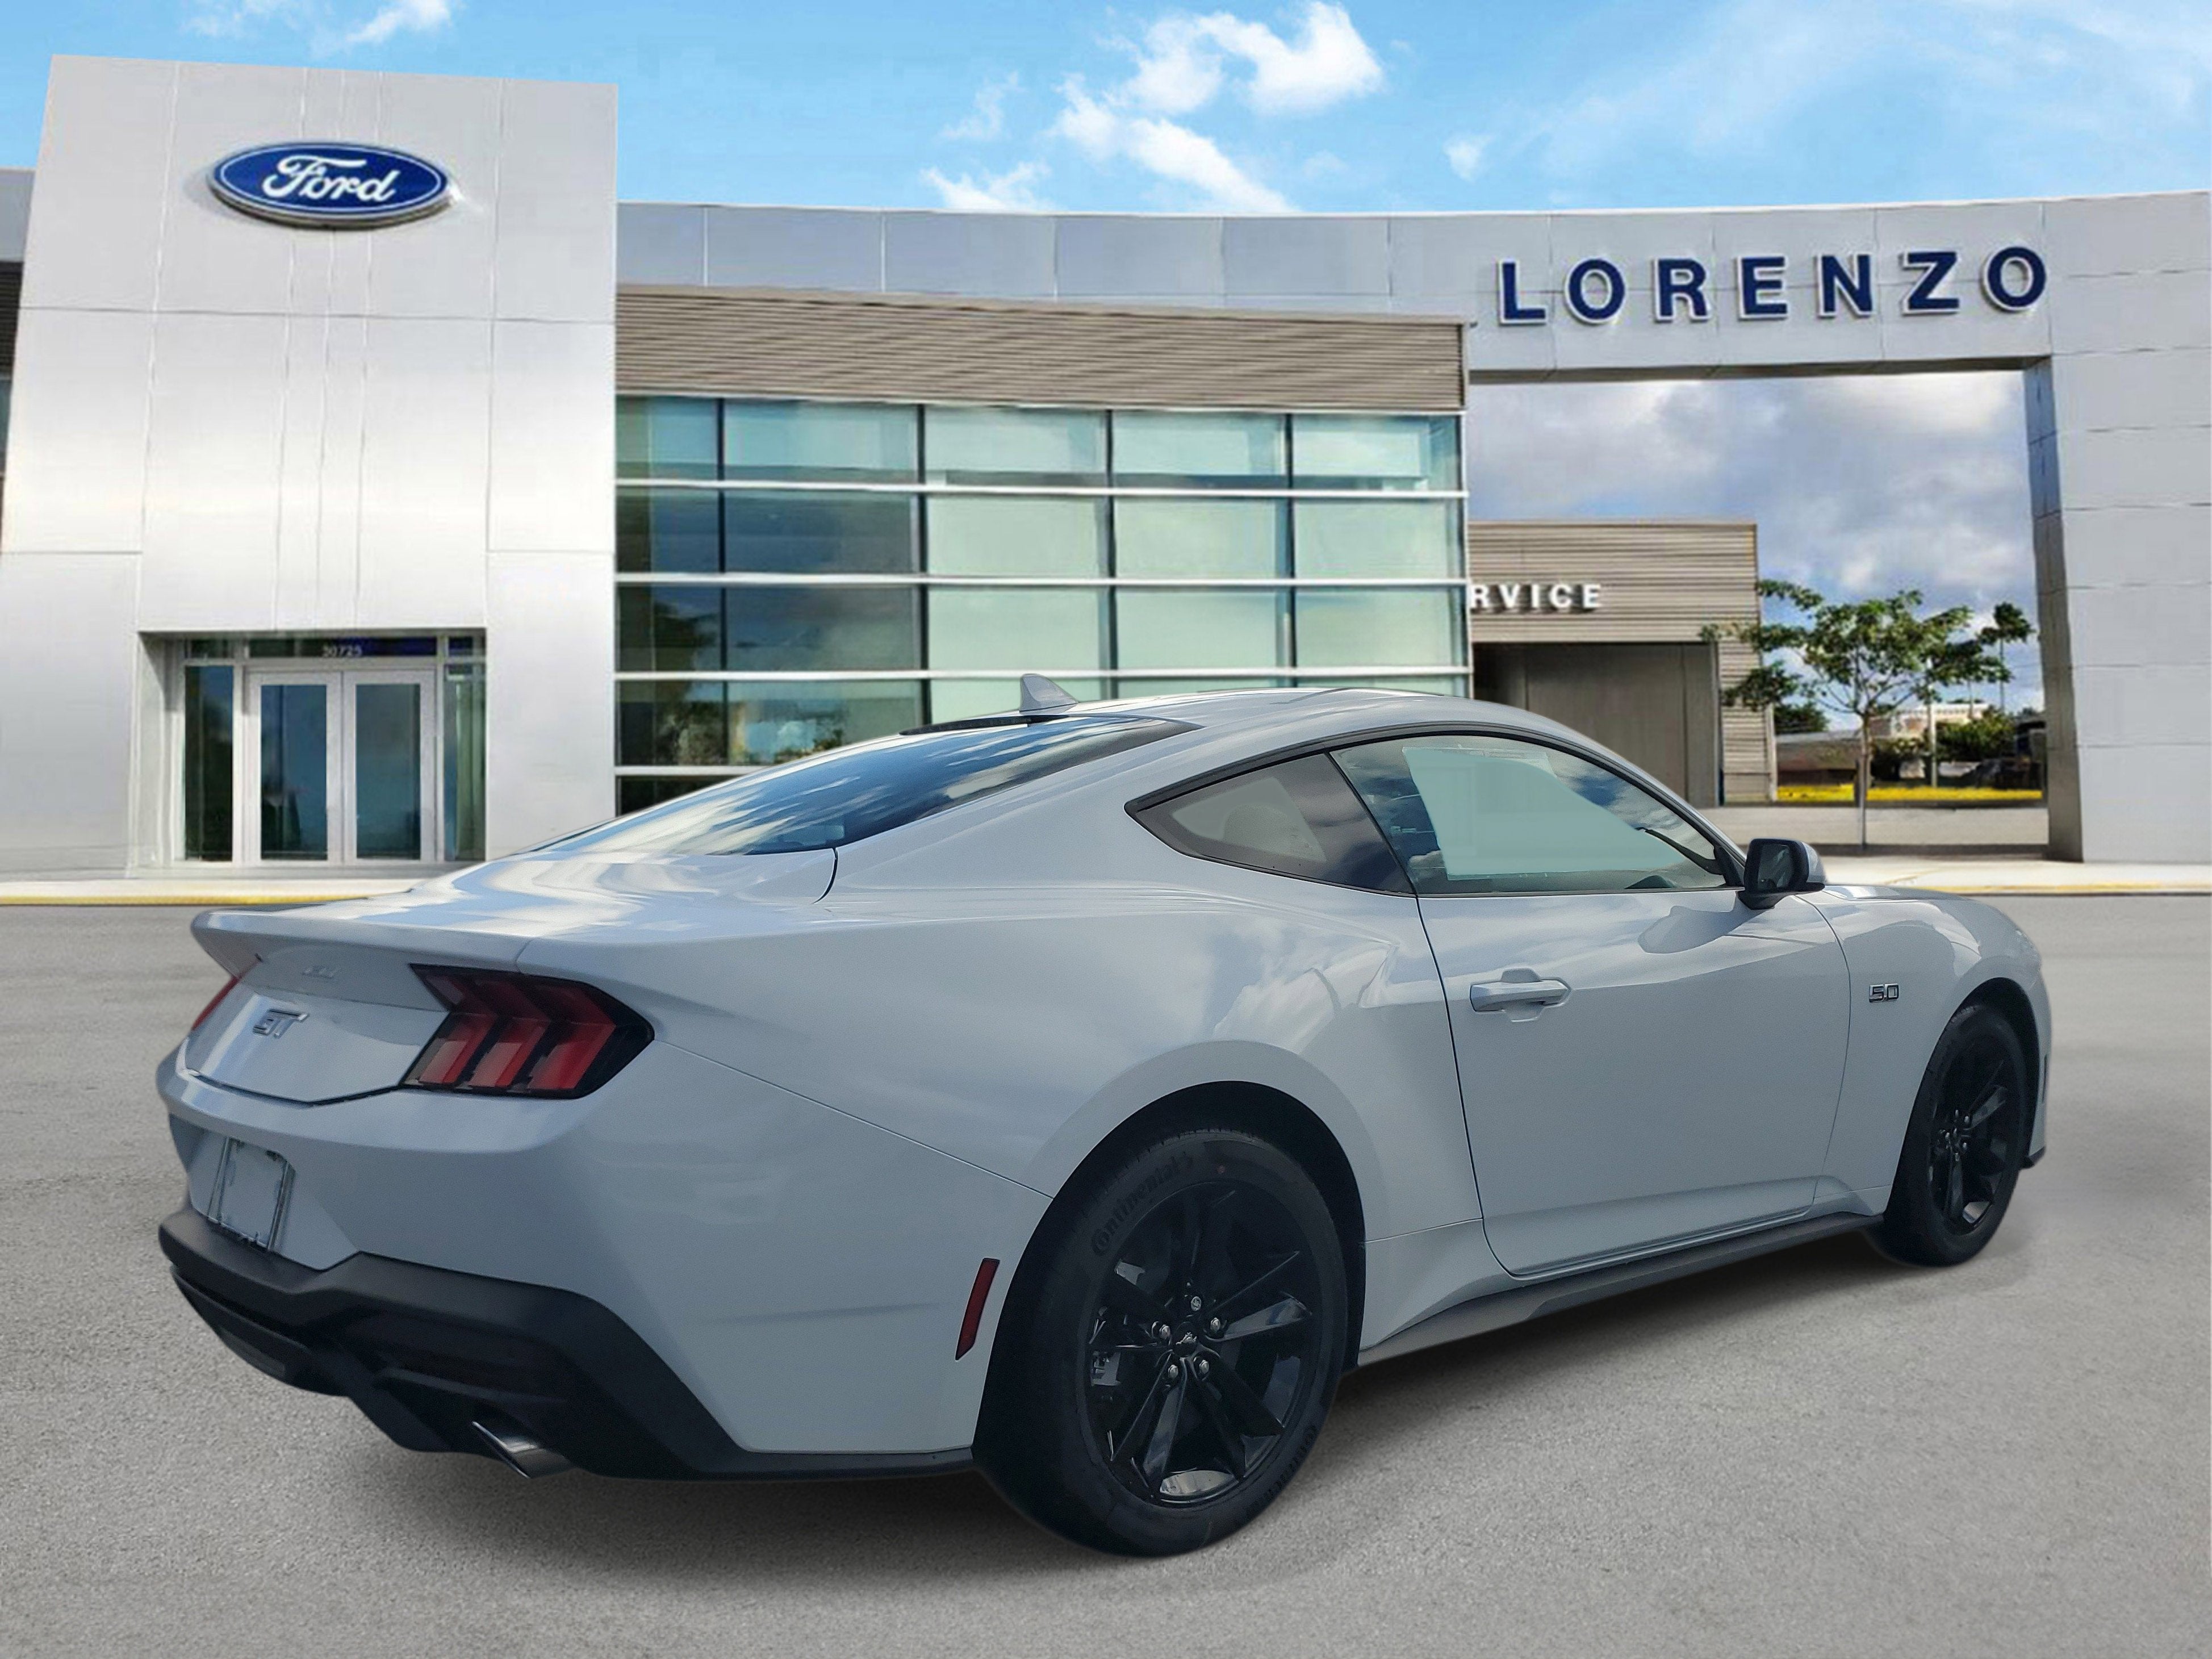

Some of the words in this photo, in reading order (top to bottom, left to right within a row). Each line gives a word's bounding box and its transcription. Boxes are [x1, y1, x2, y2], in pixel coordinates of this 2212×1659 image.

[262, 154, 400, 202] Ford
[1500, 245, 2047, 323] LORENZO
[1090, 1156, 1181, 1257] Continental
